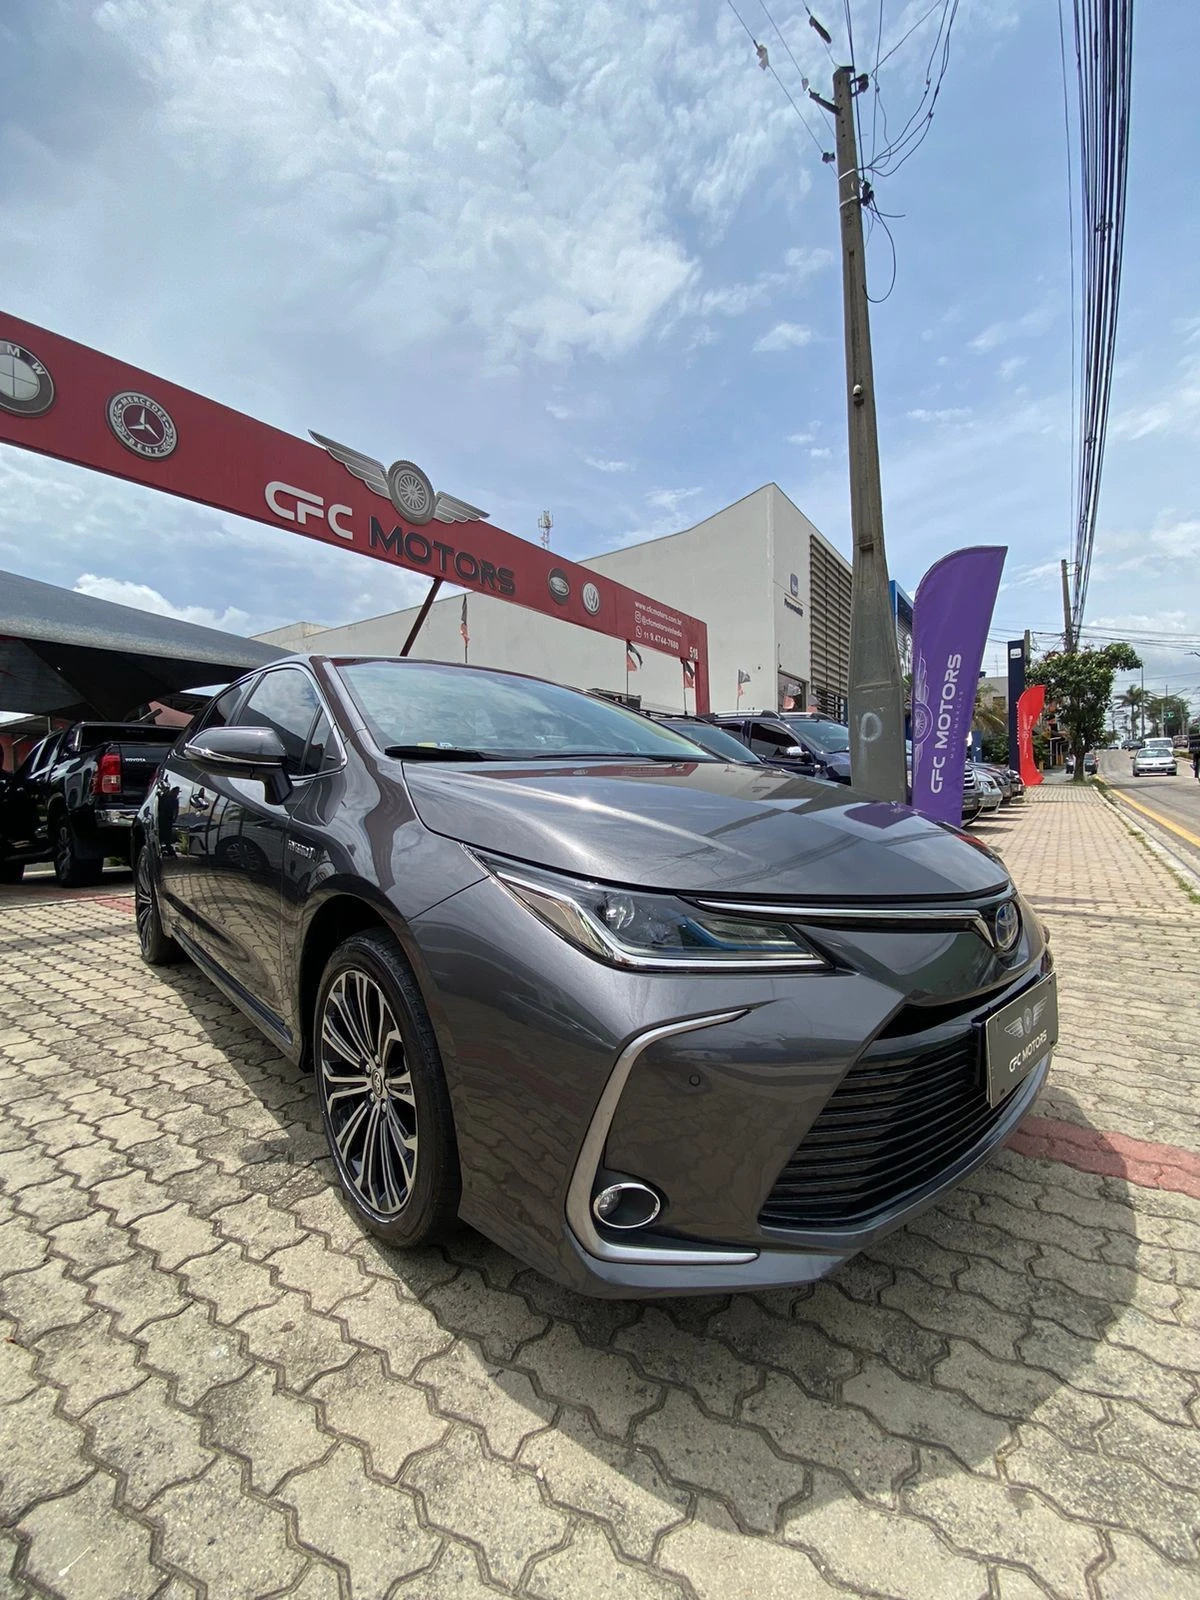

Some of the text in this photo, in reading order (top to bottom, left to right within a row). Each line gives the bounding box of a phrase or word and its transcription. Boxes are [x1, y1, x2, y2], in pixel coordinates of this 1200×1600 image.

[120, 395, 168, 425] MERCEDES
[128, 437, 161, 455] BENZ
[264, 480, 516, 596] CFC MOTORS
[930, 653, 962, 794] CFC MOTORS
[1009, 1052, 1022, 1073] CFC
[1022, 1031, 1047, 1061] MOTORS
